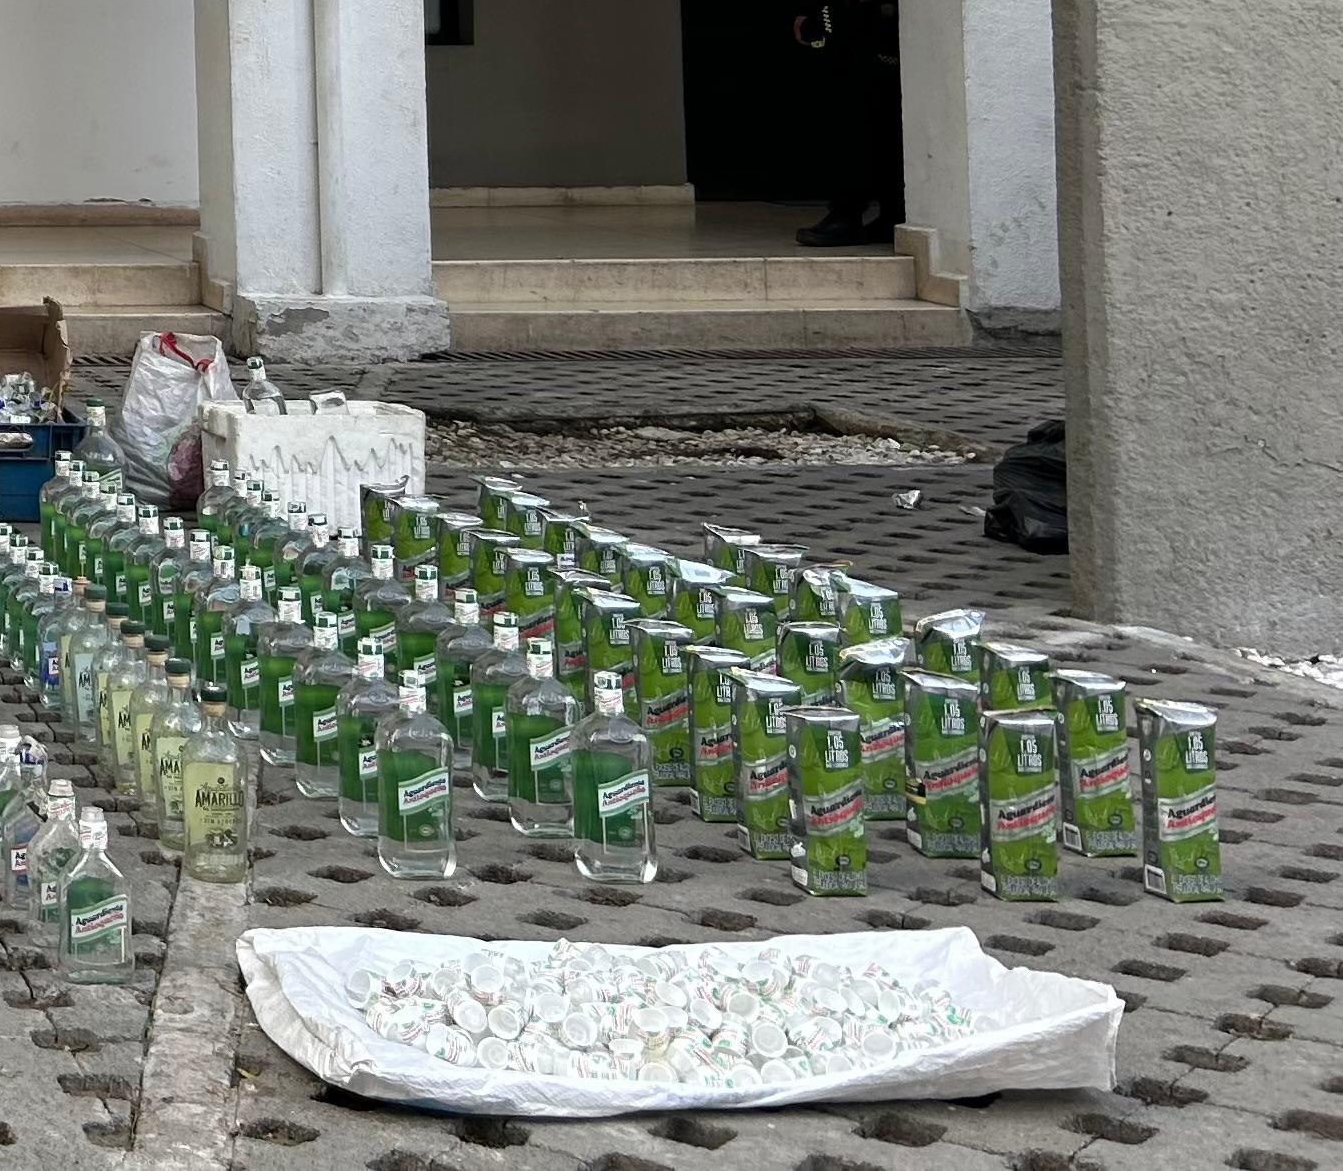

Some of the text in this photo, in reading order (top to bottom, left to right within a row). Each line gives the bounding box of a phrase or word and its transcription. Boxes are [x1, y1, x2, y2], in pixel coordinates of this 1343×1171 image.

[1018, 669, 1032, 683] 1.05
[944, 704, 961, 718] 1.05
[1098, 698, 1114, 713] 1.05
[941, 718, 965, 731] LITROS
[827, 735, 844, 749] 1.05
[1020, 739, 1038, 754] 1.05
[1188, 736, 1204, 751] 1.05
[825, 749, 849, 763] LITROS
[1017, 754, 1042, 767] LITROS
[195, 789, 244, 808] AMARILLO
